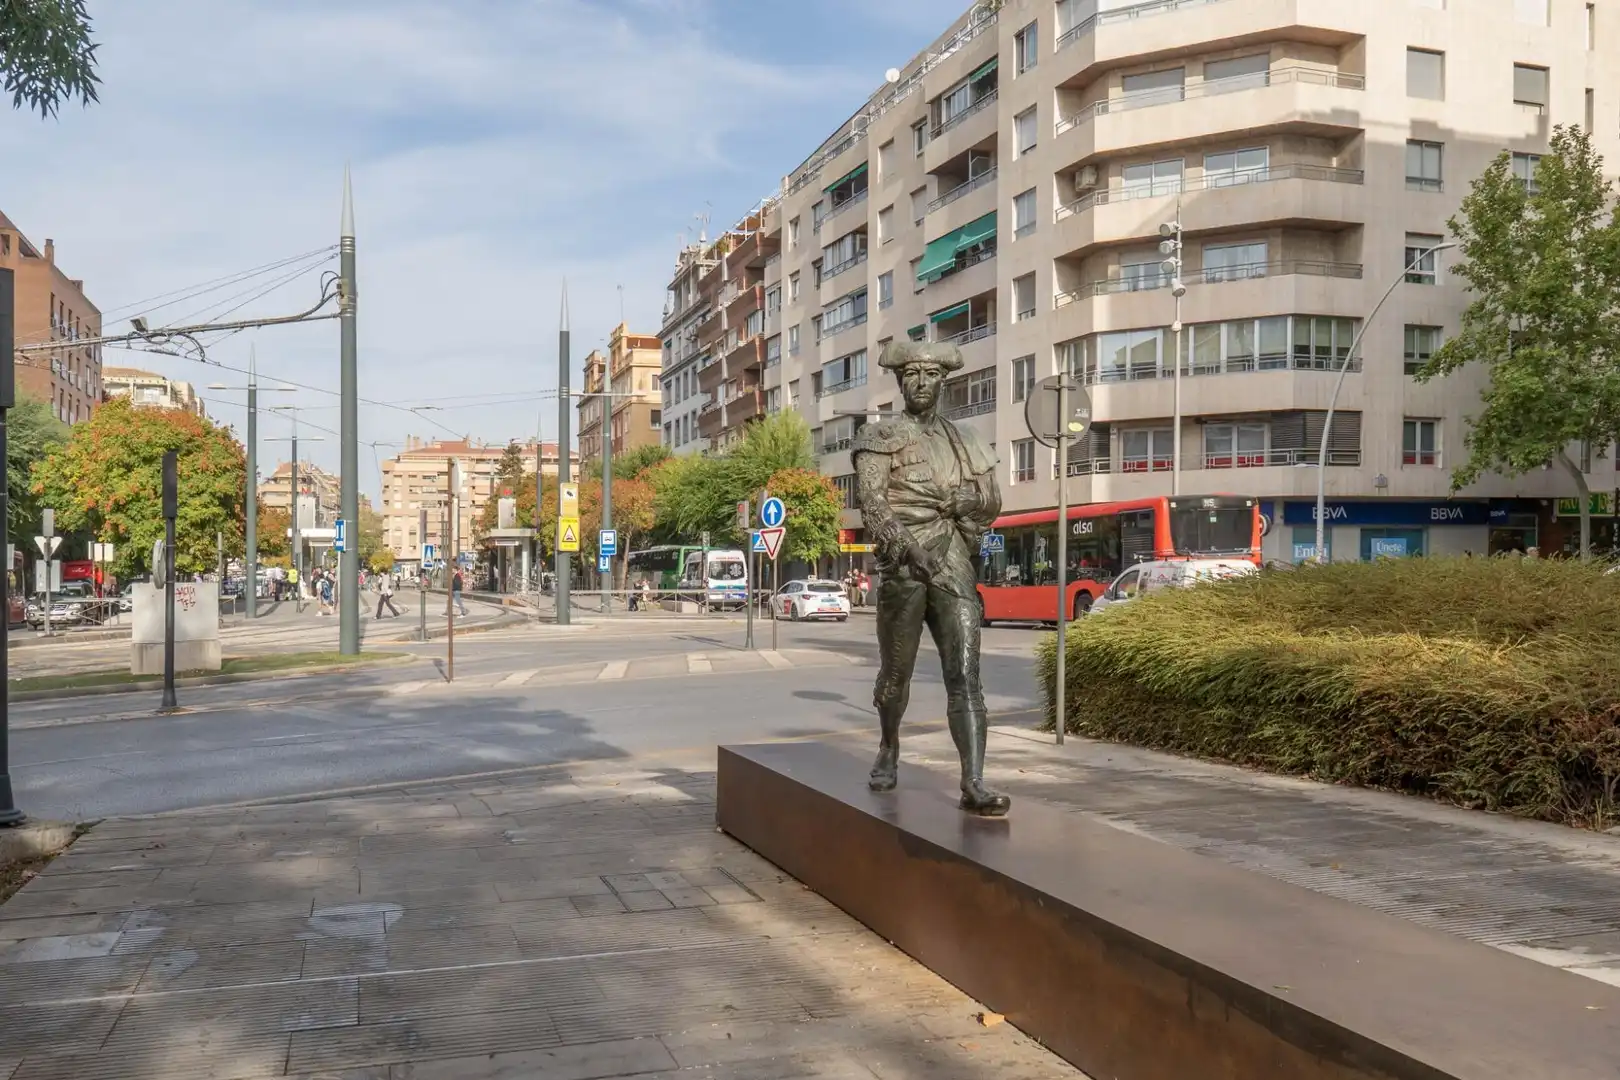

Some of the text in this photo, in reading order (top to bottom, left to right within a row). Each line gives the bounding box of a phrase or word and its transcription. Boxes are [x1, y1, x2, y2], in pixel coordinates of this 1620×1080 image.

[1431, 507, 1464, 519] BBVA
[1073, 521, 1093, 535] alsa
[1294, 544, 1329, 558] Enta
